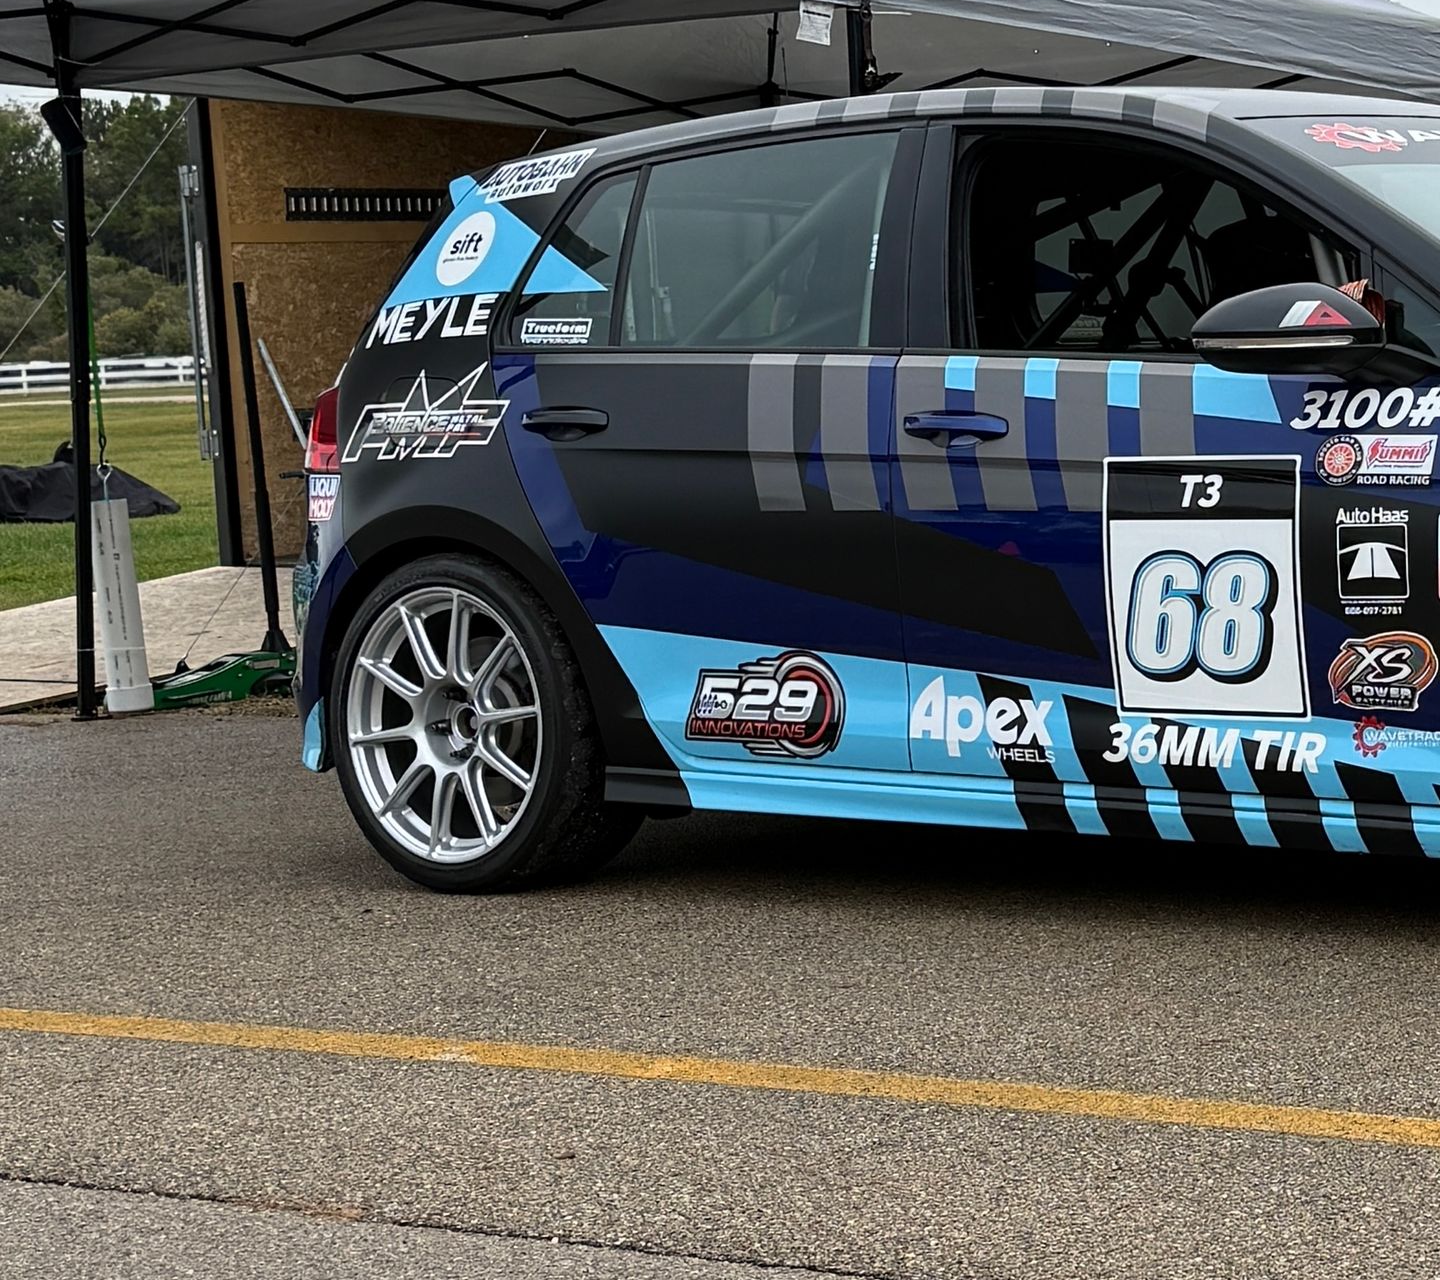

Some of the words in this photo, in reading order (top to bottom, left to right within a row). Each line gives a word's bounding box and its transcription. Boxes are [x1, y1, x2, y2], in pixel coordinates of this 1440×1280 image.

[480, 153, 590, 189] AUTOBAHN
[450, 232, 483, 255] sift
[365, 293, 499, 349] MEYLE
[1366, 438, 1434, 469] SUMMIT
[310, 477, 338, 497] LIQUI
[1180, 474, 1224, 508] T3
[1356, 475, 1386, 485] ROAD
[1389, 475, 1430, 486] RACING
[1125, 549, 1279, 684] 68
[1339, 646, 1412, 690] XS
[695, 676, 818, 722] 529
[1352, 685, 1412, 699] POWER
[691, 719, 806, 738] INNOVATIONS
[909, 675, 1054, 757] Apex
[986, 747, 1056, 764] WHEELS
[1102, 723, 1241, 769] 36MM
[1253, 730, 1327, 774] TIR
